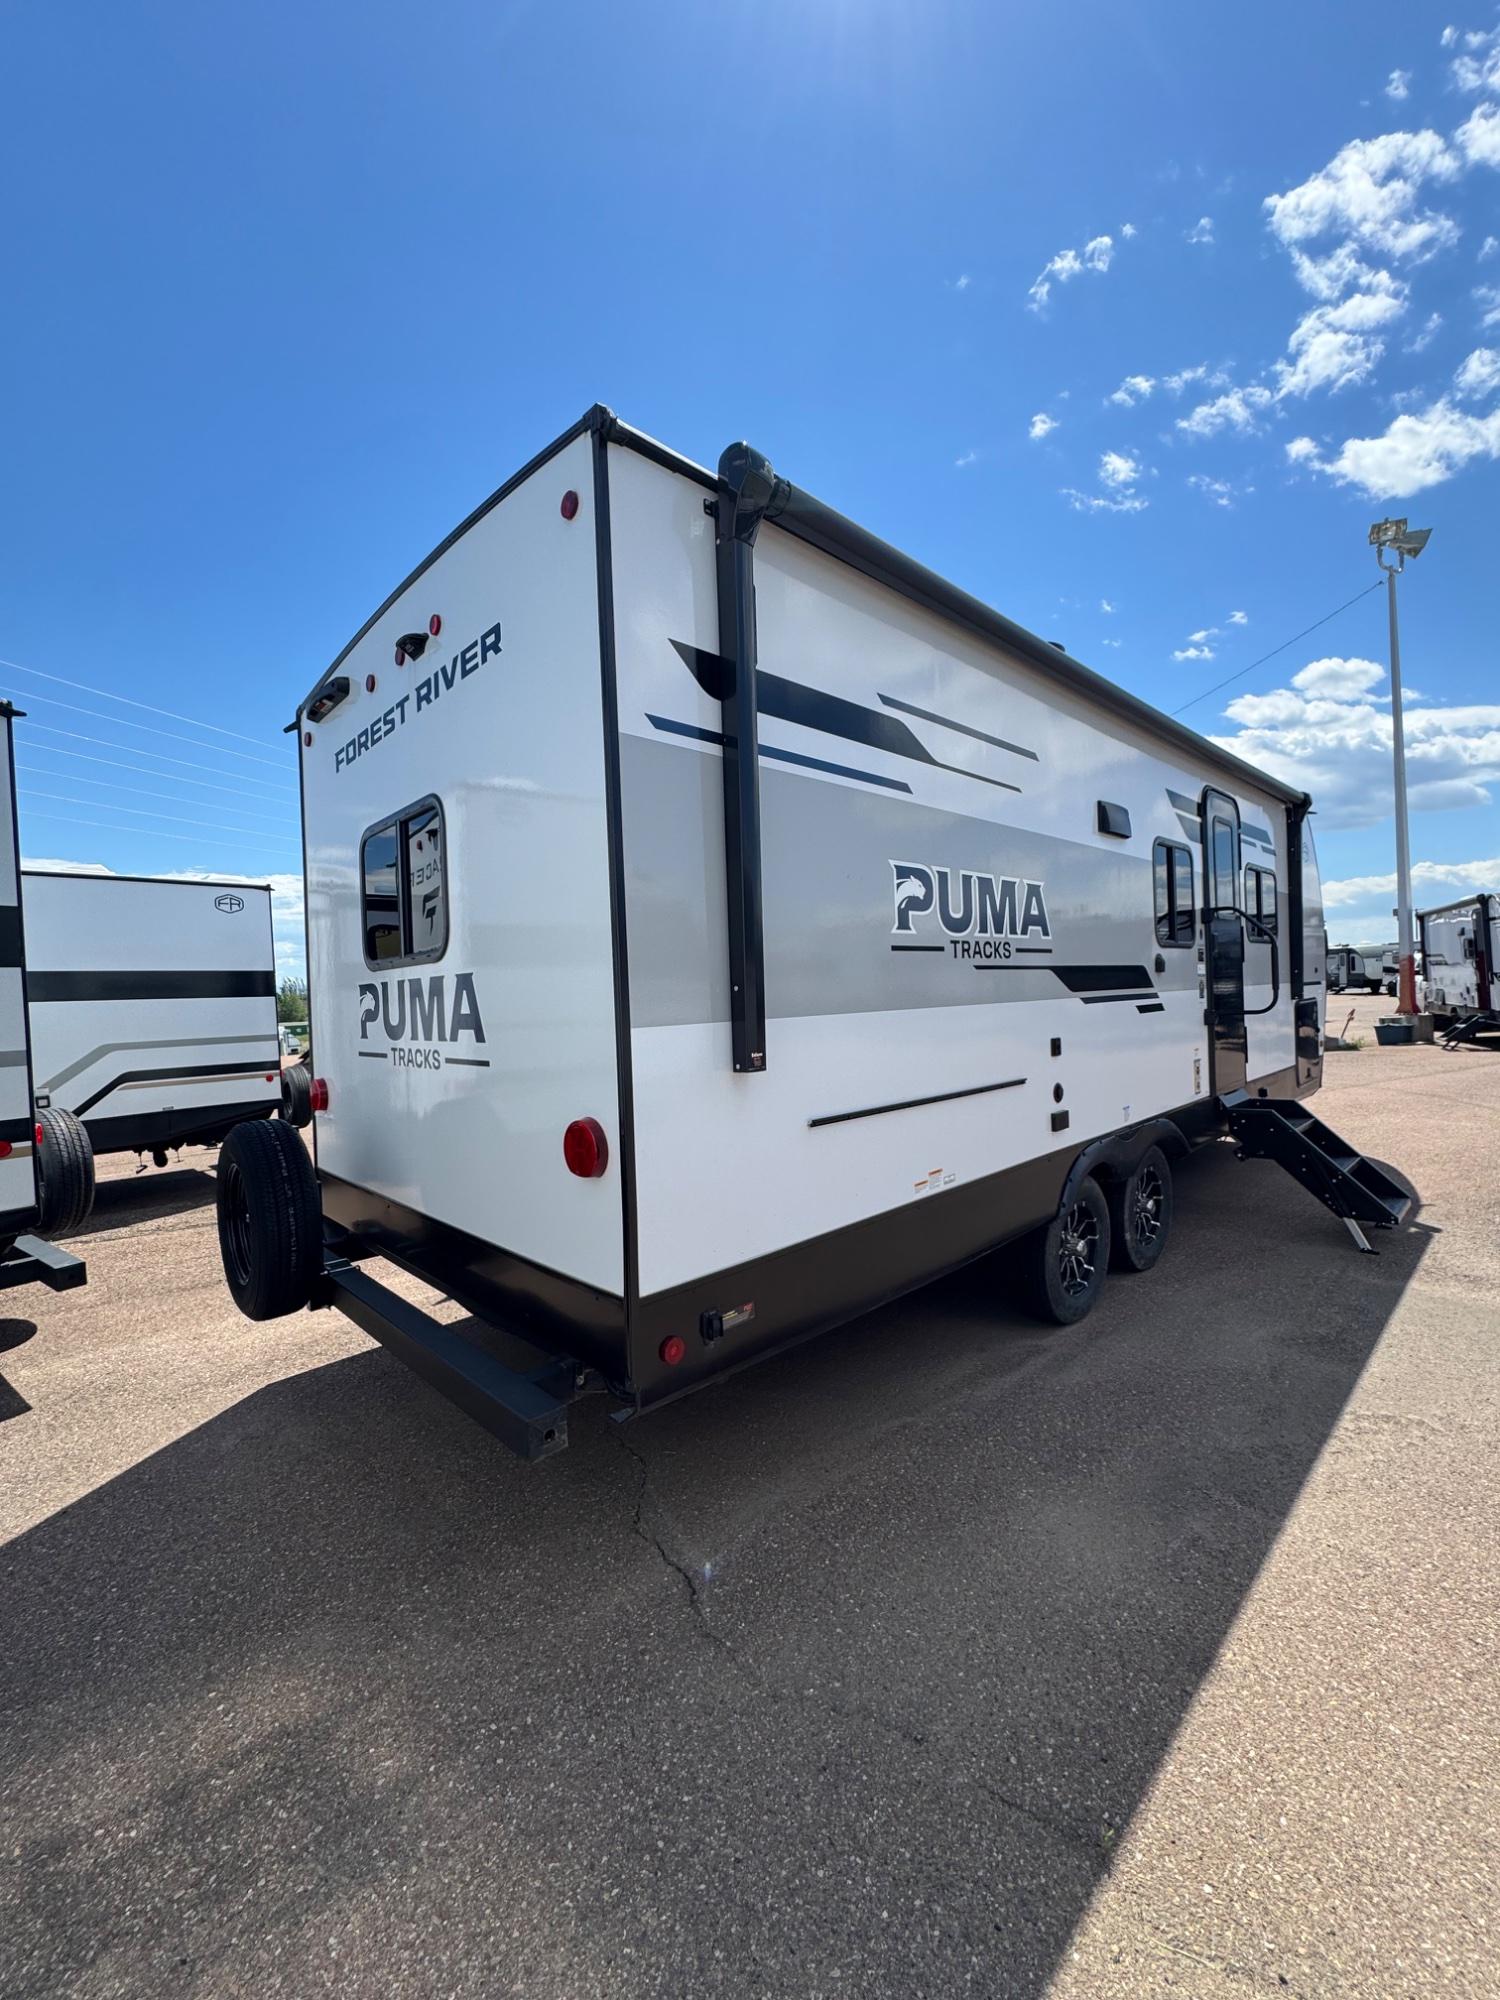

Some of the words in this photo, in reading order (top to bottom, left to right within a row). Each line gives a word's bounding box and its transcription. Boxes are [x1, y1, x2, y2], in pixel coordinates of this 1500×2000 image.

[334, 693, 410, 774] FOREST
[415, 622, 503, 713] RIVER
[217, 897, 241, 911] FR
[888, 859, 1052, 940] PUMA
[950, 940, 1012, 960] TRACKS
[358, 972, 486, 1044] PUMA
[391, 1047, 441, 1071] TRACKS
